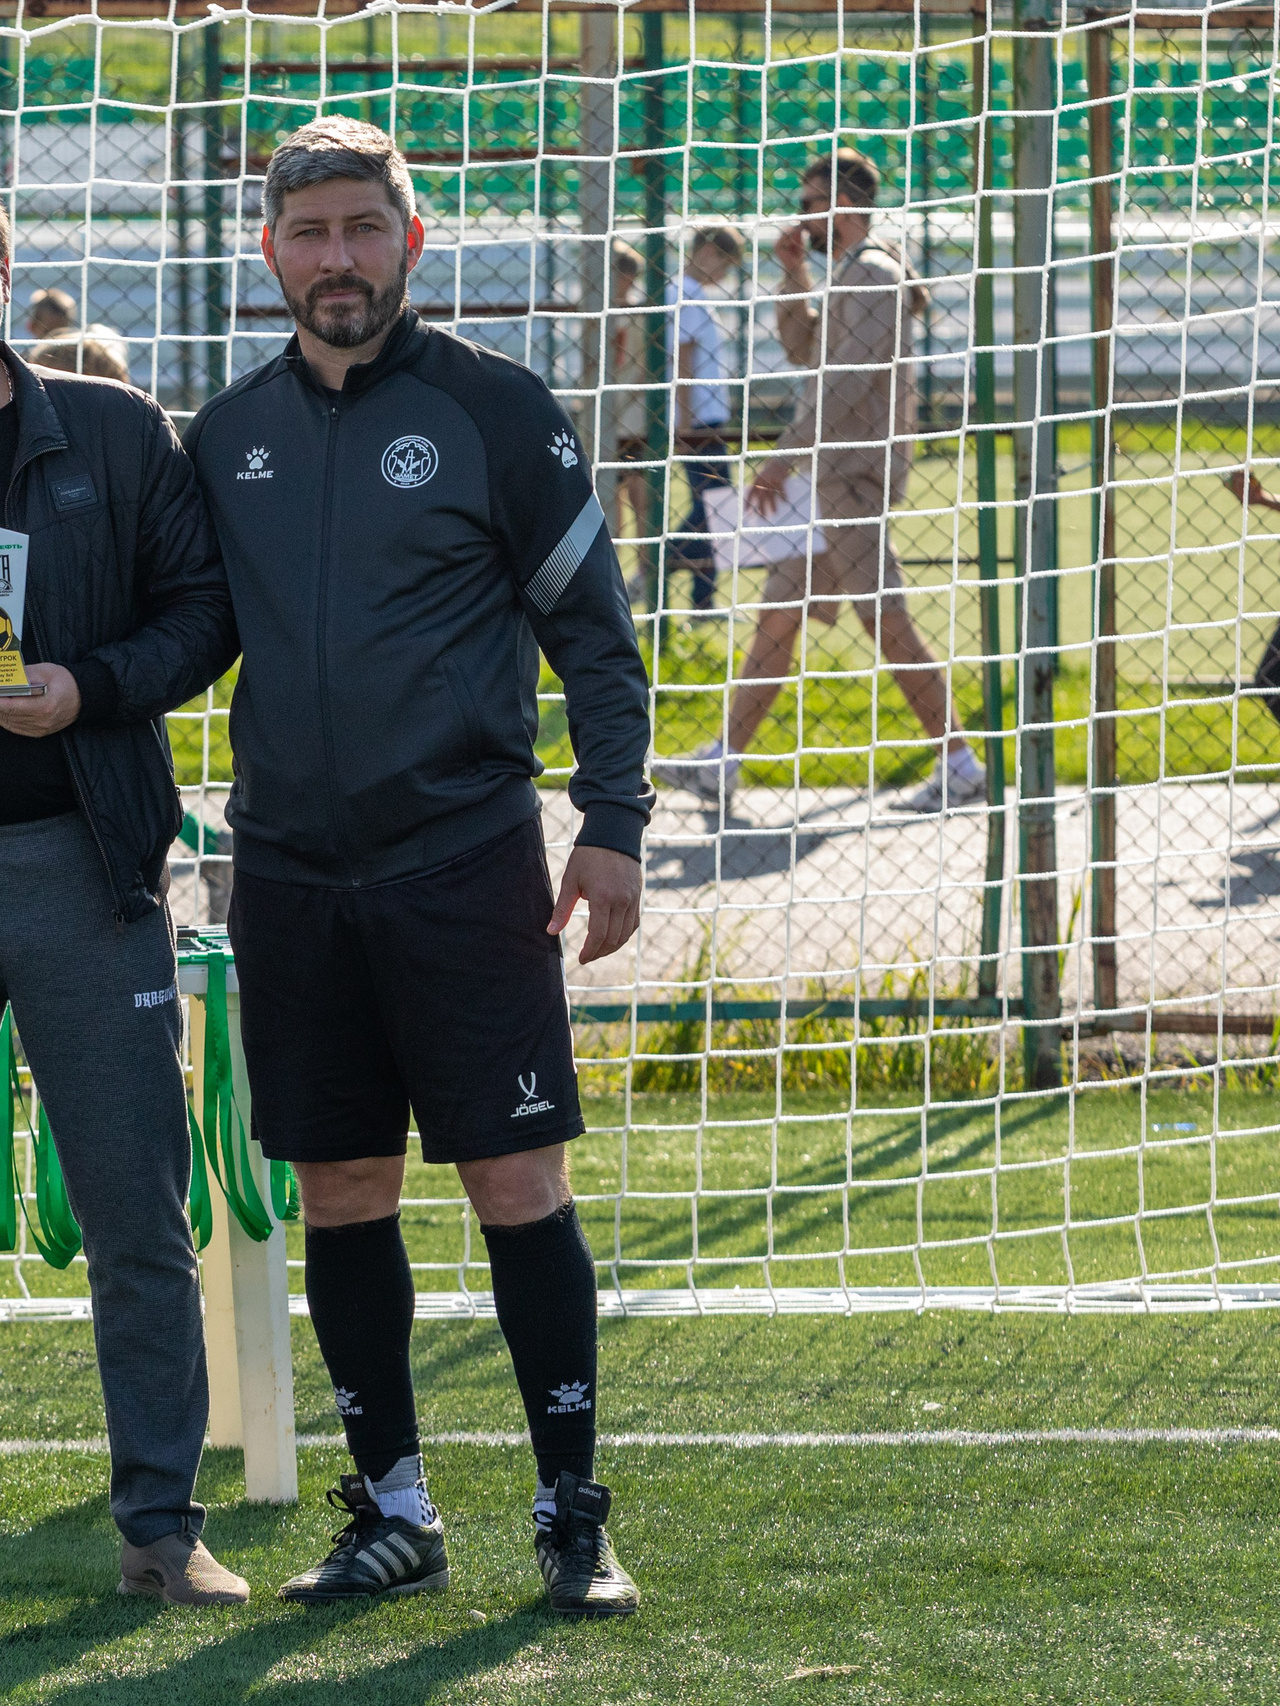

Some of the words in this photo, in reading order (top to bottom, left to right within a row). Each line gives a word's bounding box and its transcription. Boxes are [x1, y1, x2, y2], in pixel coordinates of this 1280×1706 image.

[236, 470, 274, 480] KELME
[510, 1100, 556, 1118] JÖGEL
[338, 1406, 363, 1416] LME
[547, 1399, 592, 1414] KELME
